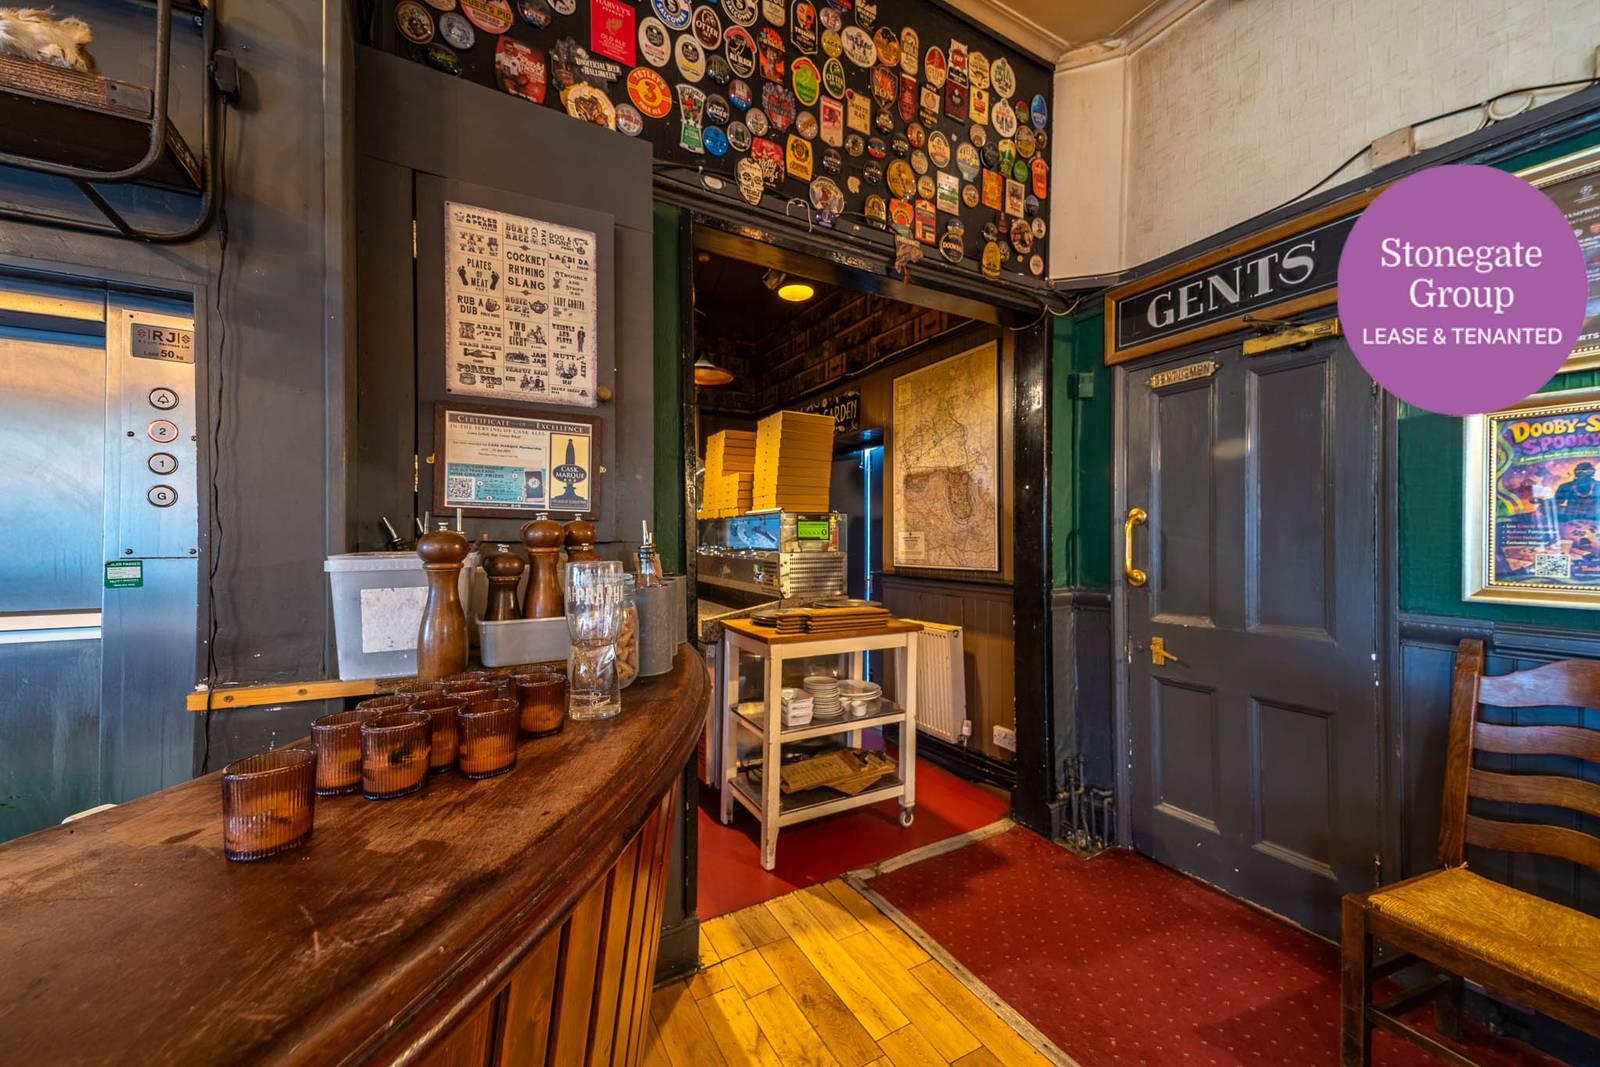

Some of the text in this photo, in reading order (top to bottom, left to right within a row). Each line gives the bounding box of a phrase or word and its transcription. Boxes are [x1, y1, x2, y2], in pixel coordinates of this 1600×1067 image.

[696, 22, 718, 38] OTTER
[632, 69, 666, 90] TETLEY'S
[466, 213, 497, 224] APPLES
[472, 219, 497, 229] PEARS
[549, 232, 565, 240] DOG
[506, 251, 546, 266] COCKNEY
[467, 258, 492, 271] PLATES
[508, 264, 545, 278] RHYMING
[560, 272, 588, 281] TROUBLE
[471, 277, 488, 288] MEAT
[508, 276, 545, 290] SLANG
[1146, 240, 1315, 329] GENTS
[457, 295, 484, 307] RUB A
[553, 296, 566, 306] LADY
[460, 305, 477, 315] DUB
[509, 321, 526, 332] TWO
[509, 336, 527, 347] EIGHT
[161, 350, 174, 358] 50
[457, 415, 509, 426] CERTIFICATE
[536, 422, 583, 433] EXCELLENCE
[159, 427, 167, 436] 2
[157, 492, 167, 500] G
